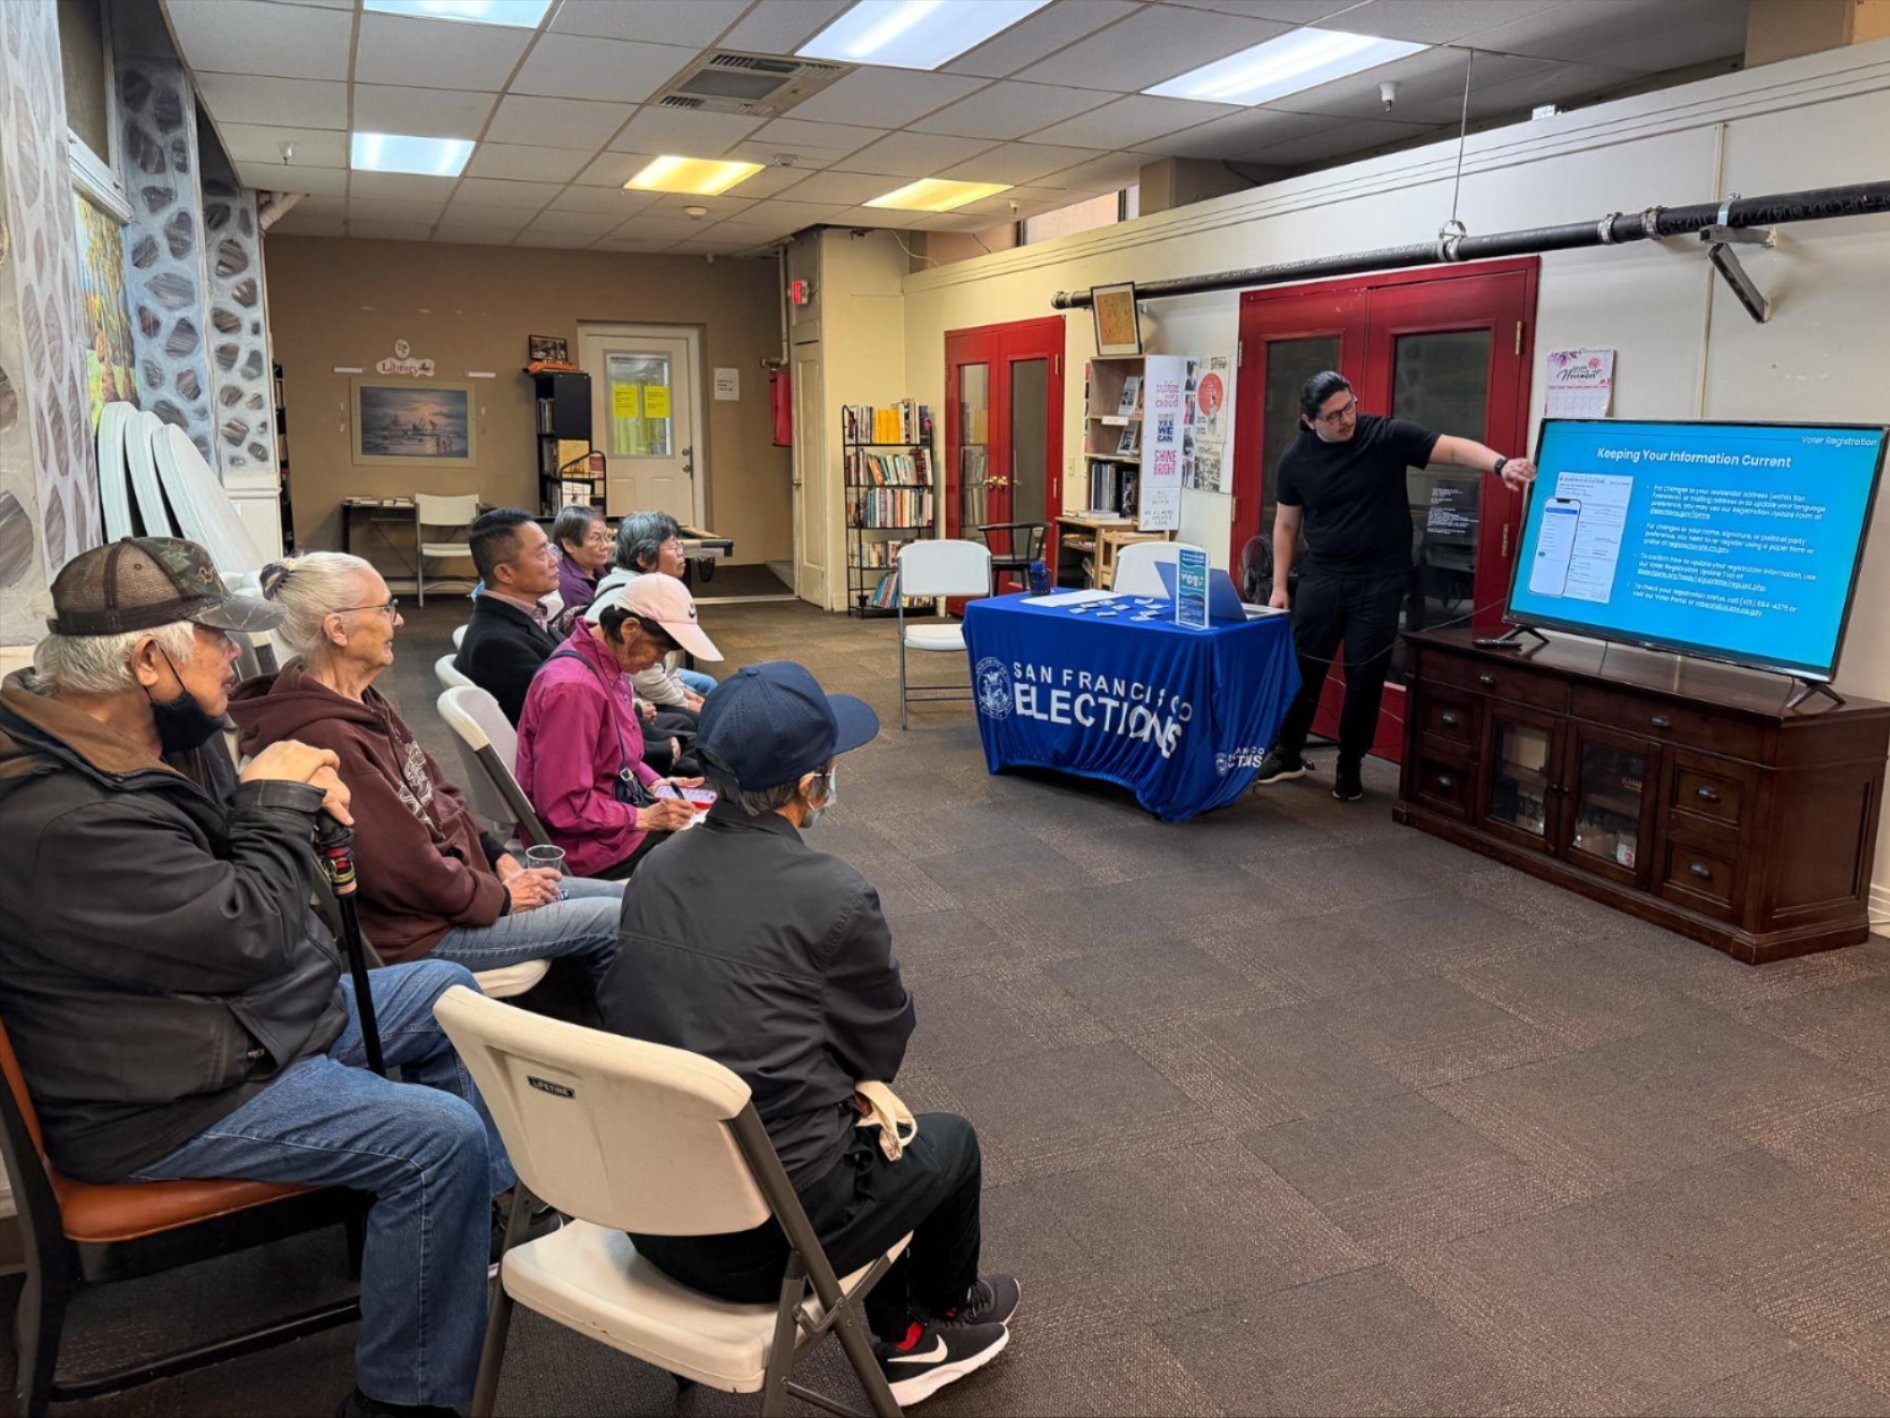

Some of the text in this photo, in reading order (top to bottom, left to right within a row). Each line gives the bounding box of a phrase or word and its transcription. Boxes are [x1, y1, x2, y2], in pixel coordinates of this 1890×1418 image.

[382, 362, 419, 374] Library
[1157, 426, 1174, 435] WE
[1802, 436, 1878, 448] Voter Registration
[1154, 450, 1177, 462] SHINE
[1597, 447, 1792, 468] Keeping Your Information Current
[1013, 661, 1193, 722] SAN FRANCISCO
[1014, 682, 1183, 760] ELECTIONS
[532, 1080, 570, 1096] LIFETIME
